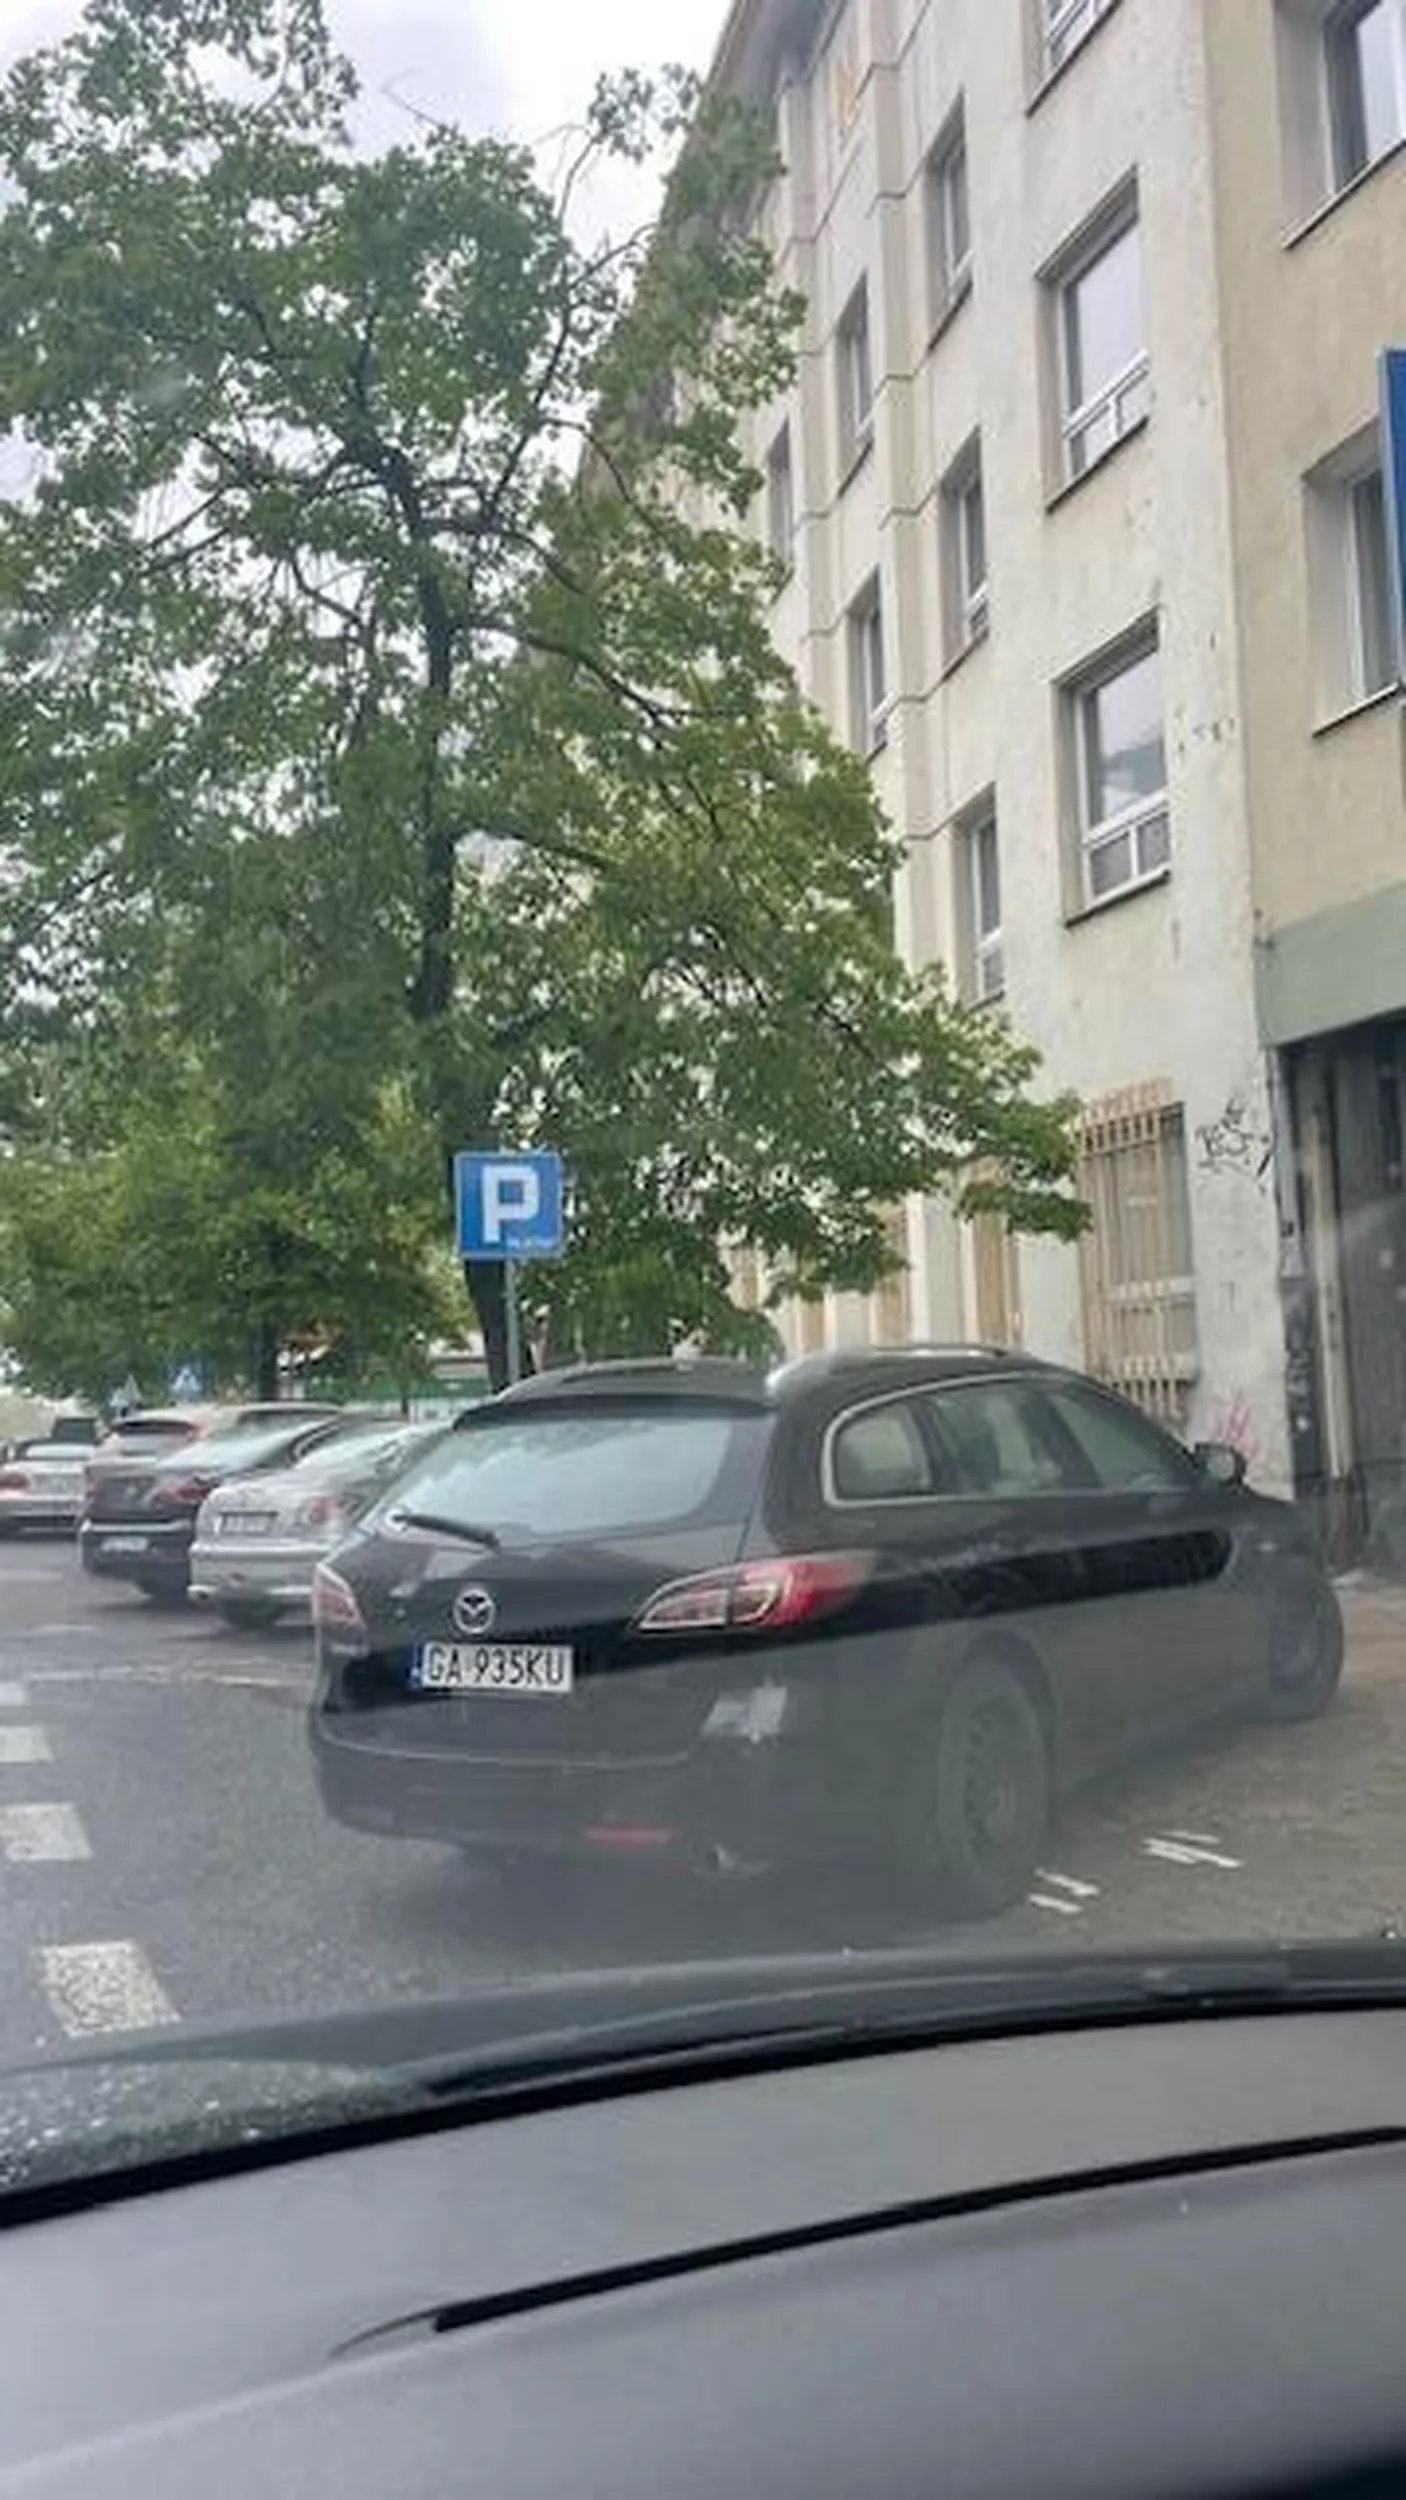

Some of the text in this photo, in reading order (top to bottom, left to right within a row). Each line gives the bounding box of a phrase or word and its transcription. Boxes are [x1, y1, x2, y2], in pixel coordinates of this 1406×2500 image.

[483, 1165, 539, 1243] P
[428, 1648, 564, 1685] GA 935KU
